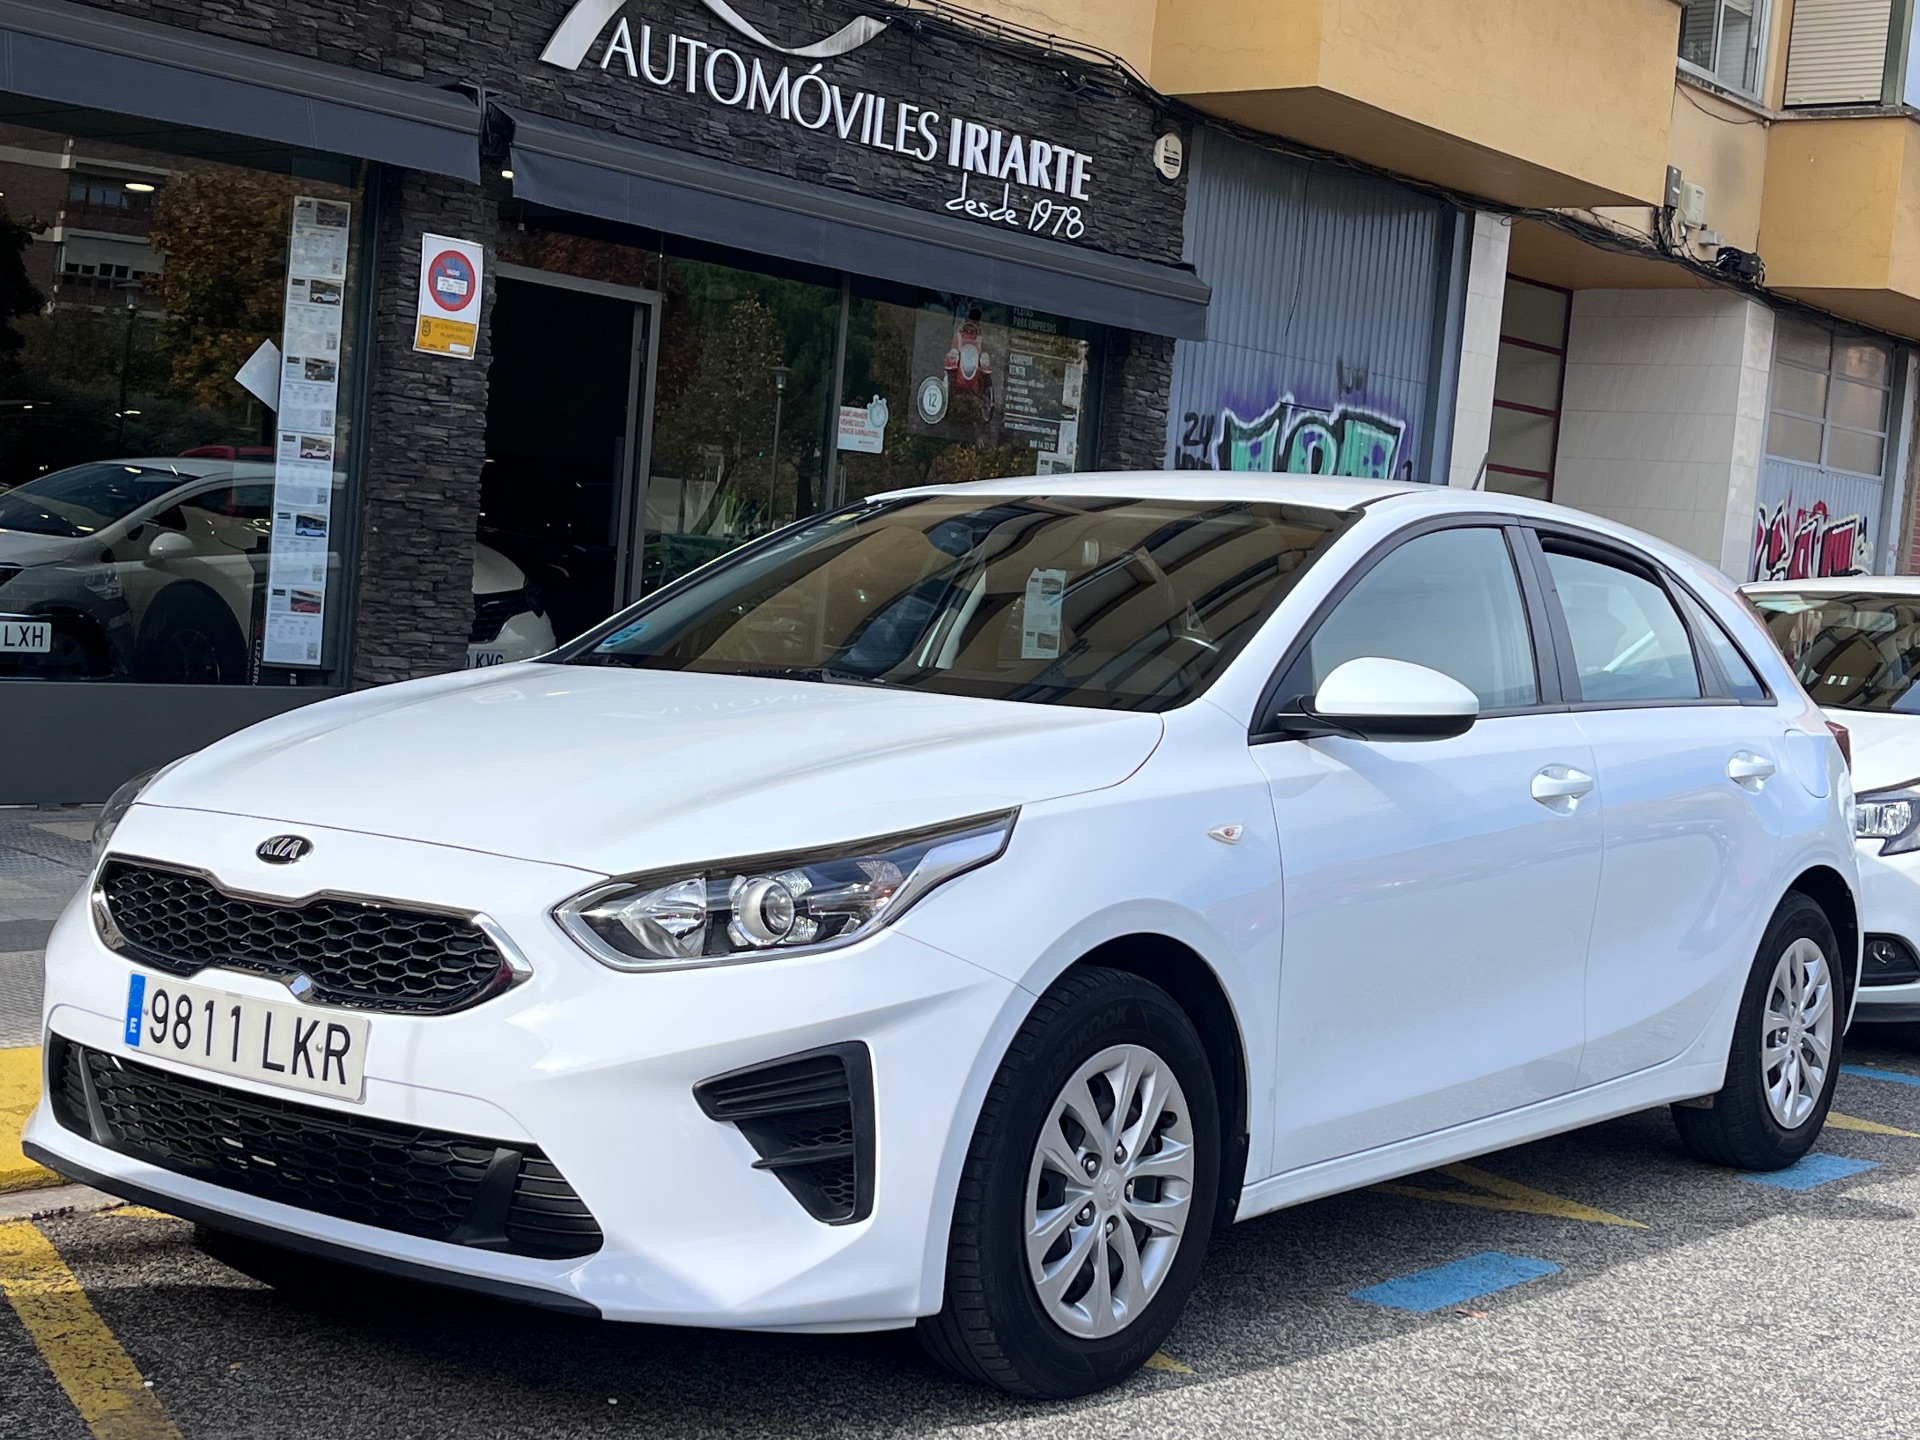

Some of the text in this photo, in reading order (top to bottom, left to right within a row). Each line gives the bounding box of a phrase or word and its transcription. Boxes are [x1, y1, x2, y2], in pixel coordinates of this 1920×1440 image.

[600, 16, 1093, 201] AUTOMÓVILES IRIARTE
[945, 172, 1085, 239] desde 1978
[928, 392, 938, 408] 12
[4, 624, 44, 648] LXH
[252, 639, 262, 687] LIZARR
[260, 837, 304, 859] KIA
[129, 1016, 138, 1034] E
[149, 988, 351, 1085] 9811 LKR
